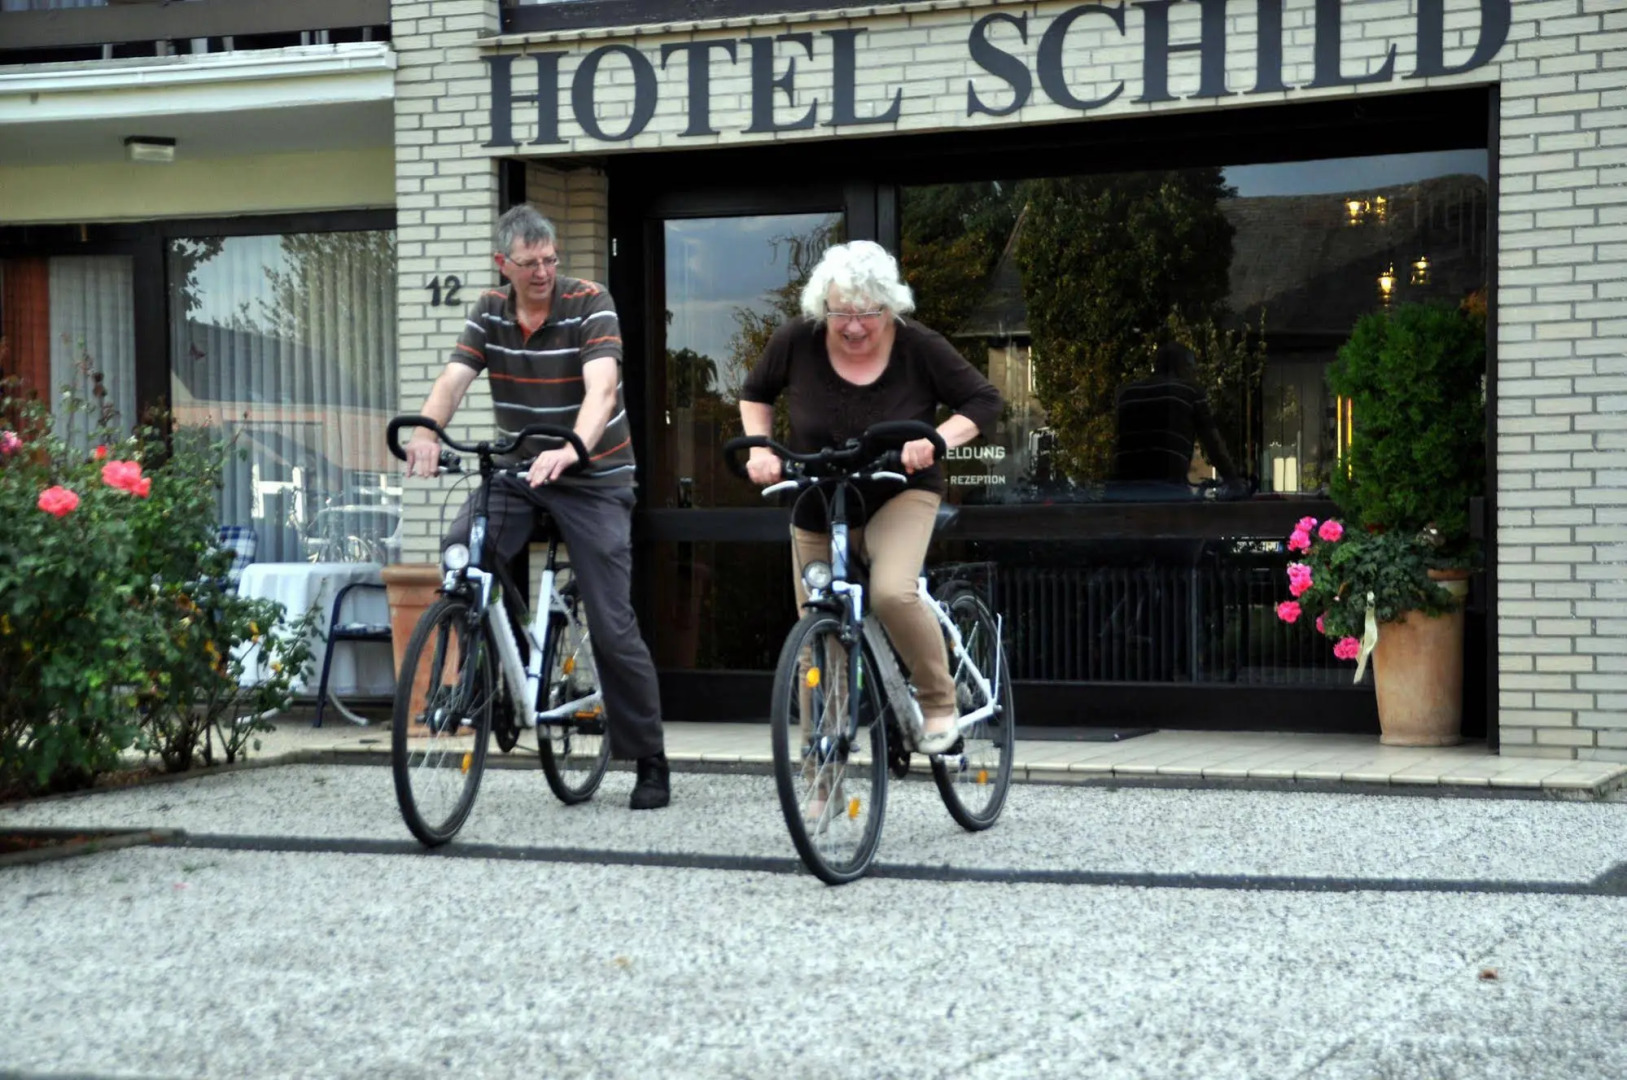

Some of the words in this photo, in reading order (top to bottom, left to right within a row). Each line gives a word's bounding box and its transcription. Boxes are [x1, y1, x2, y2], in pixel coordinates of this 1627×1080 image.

[480, 27, 902, 148] HOTEL
[967, 0, 1511, 117] SCHILD
[424, 274, 461, 307] 12
[941, 446, 1006, 460] ELDUNG
